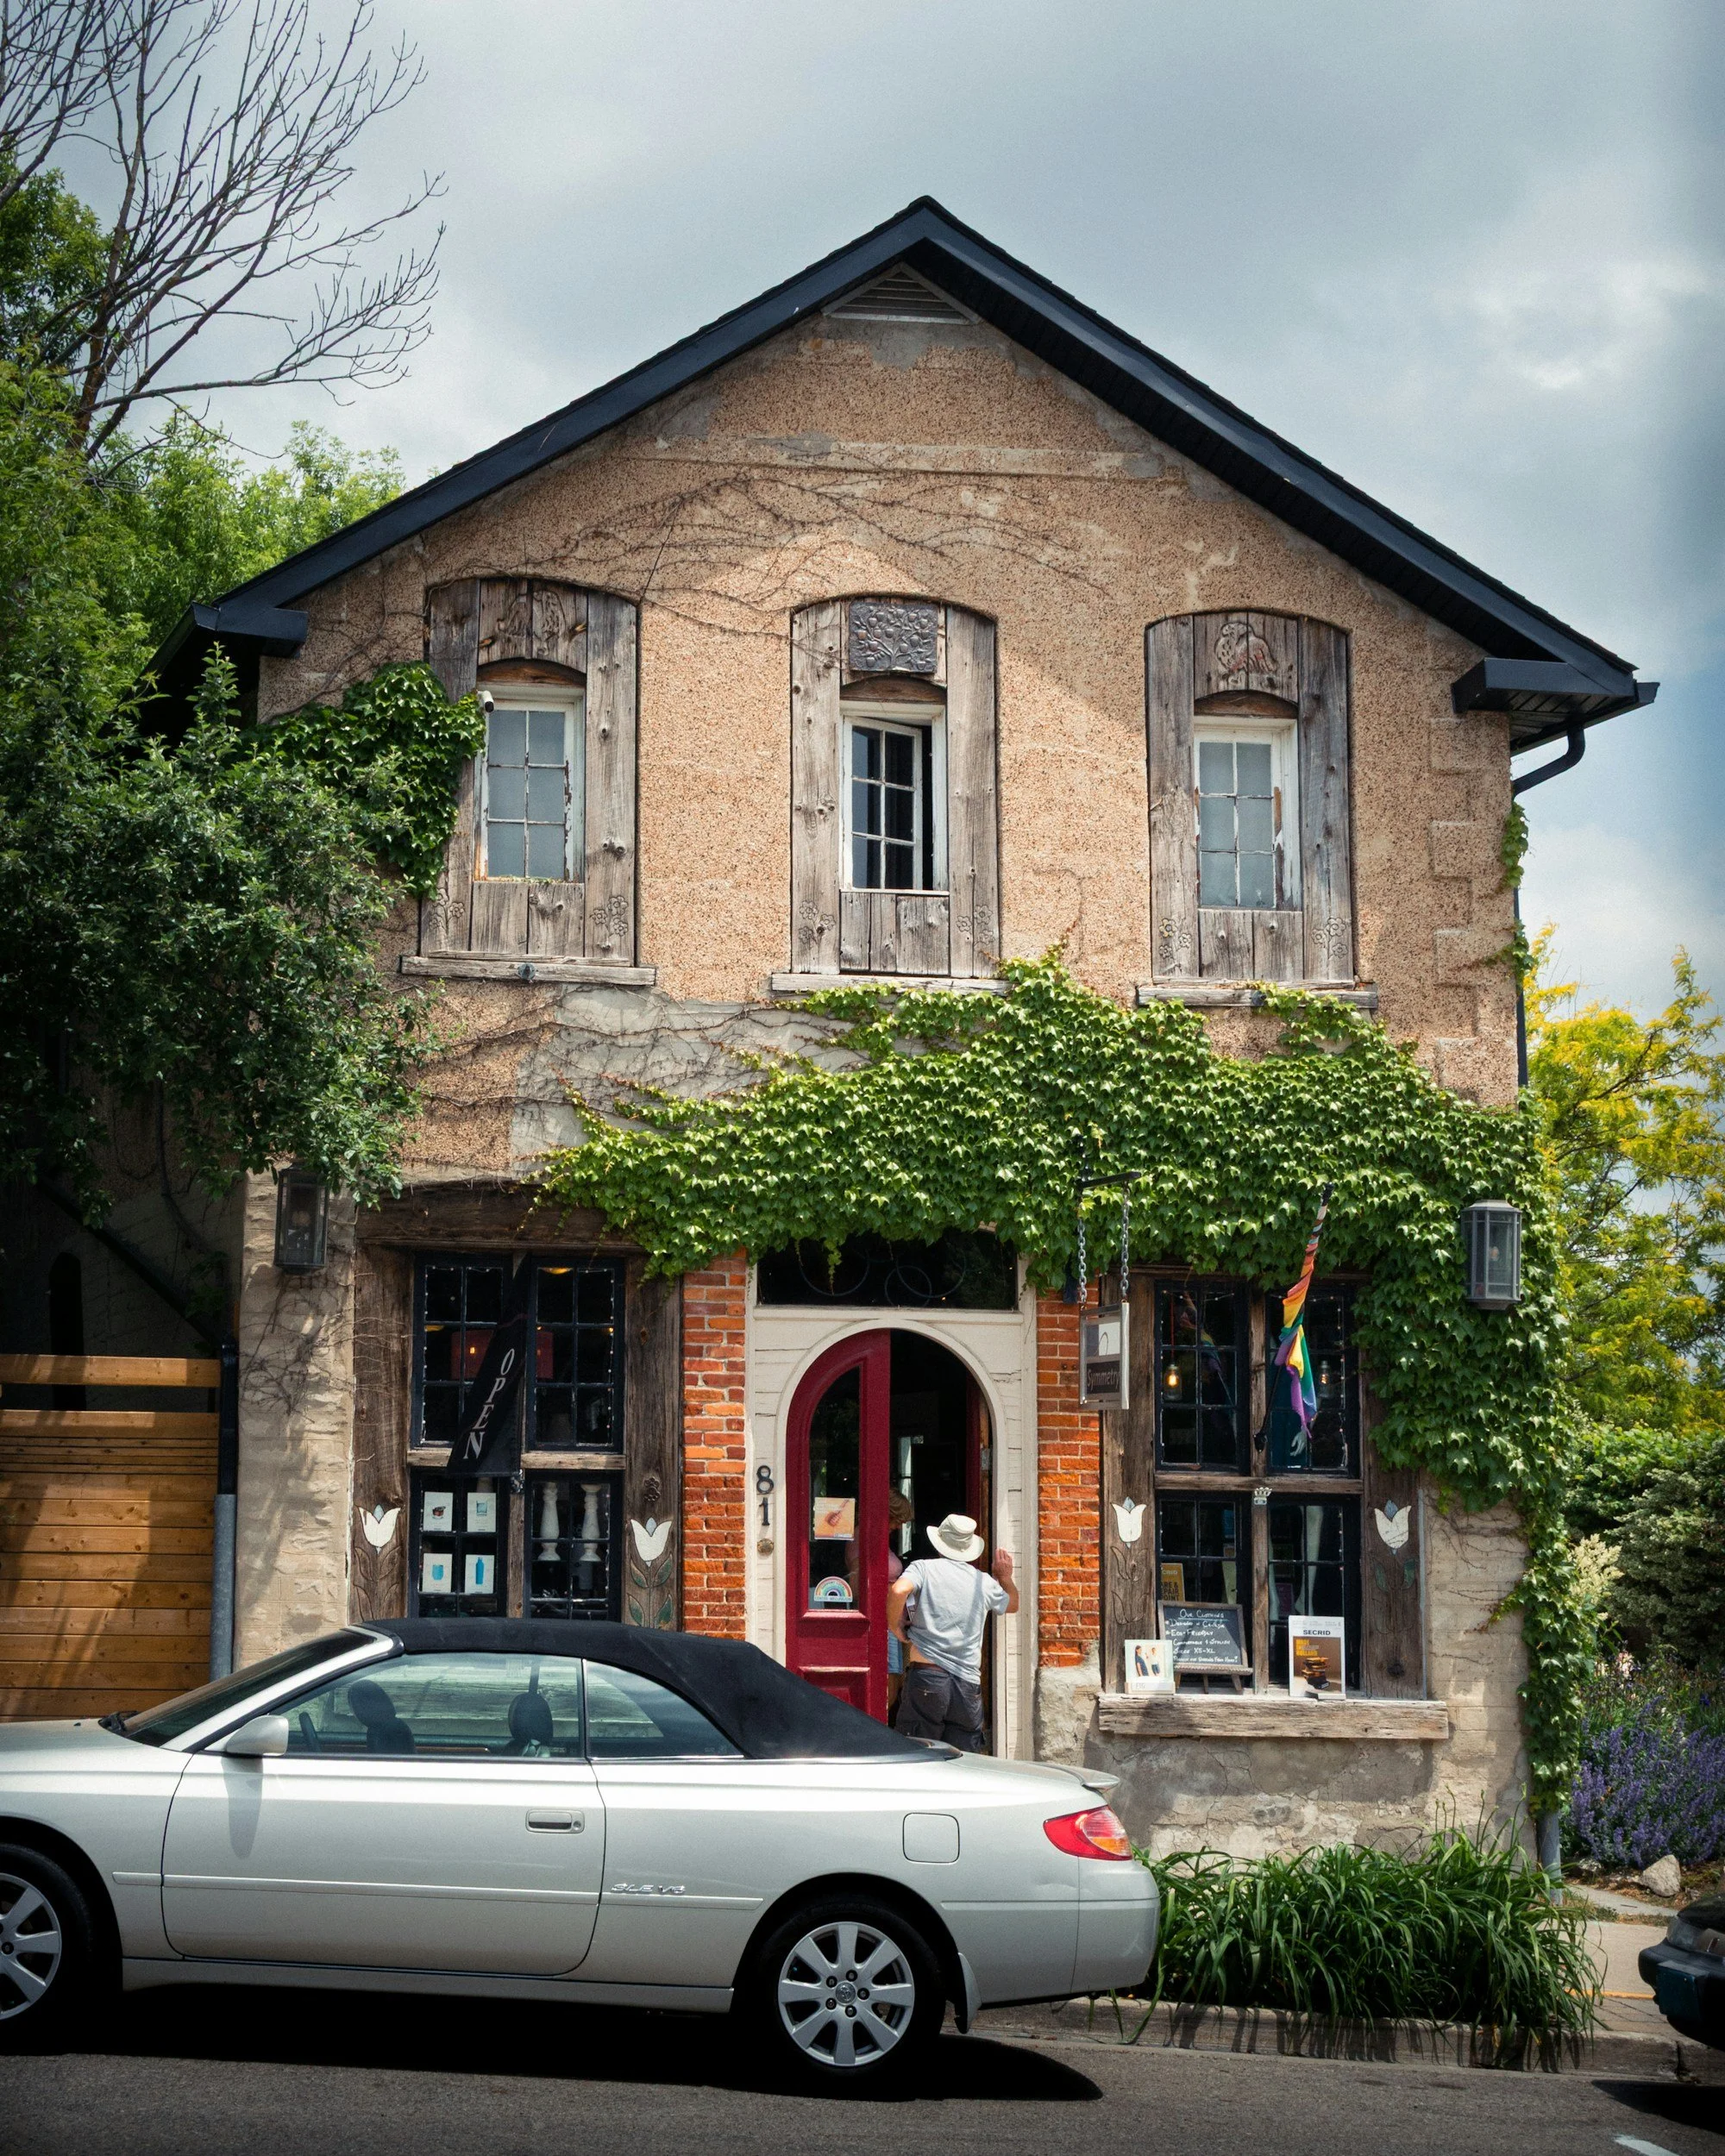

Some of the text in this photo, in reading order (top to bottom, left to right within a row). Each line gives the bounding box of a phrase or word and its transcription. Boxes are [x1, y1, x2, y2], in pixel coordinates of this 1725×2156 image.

[463, 1348, 515, 1459] OPEN
[1088, 1369, 1120, 1392] Symmetry
[756, 1465, 775, 1526] 81
